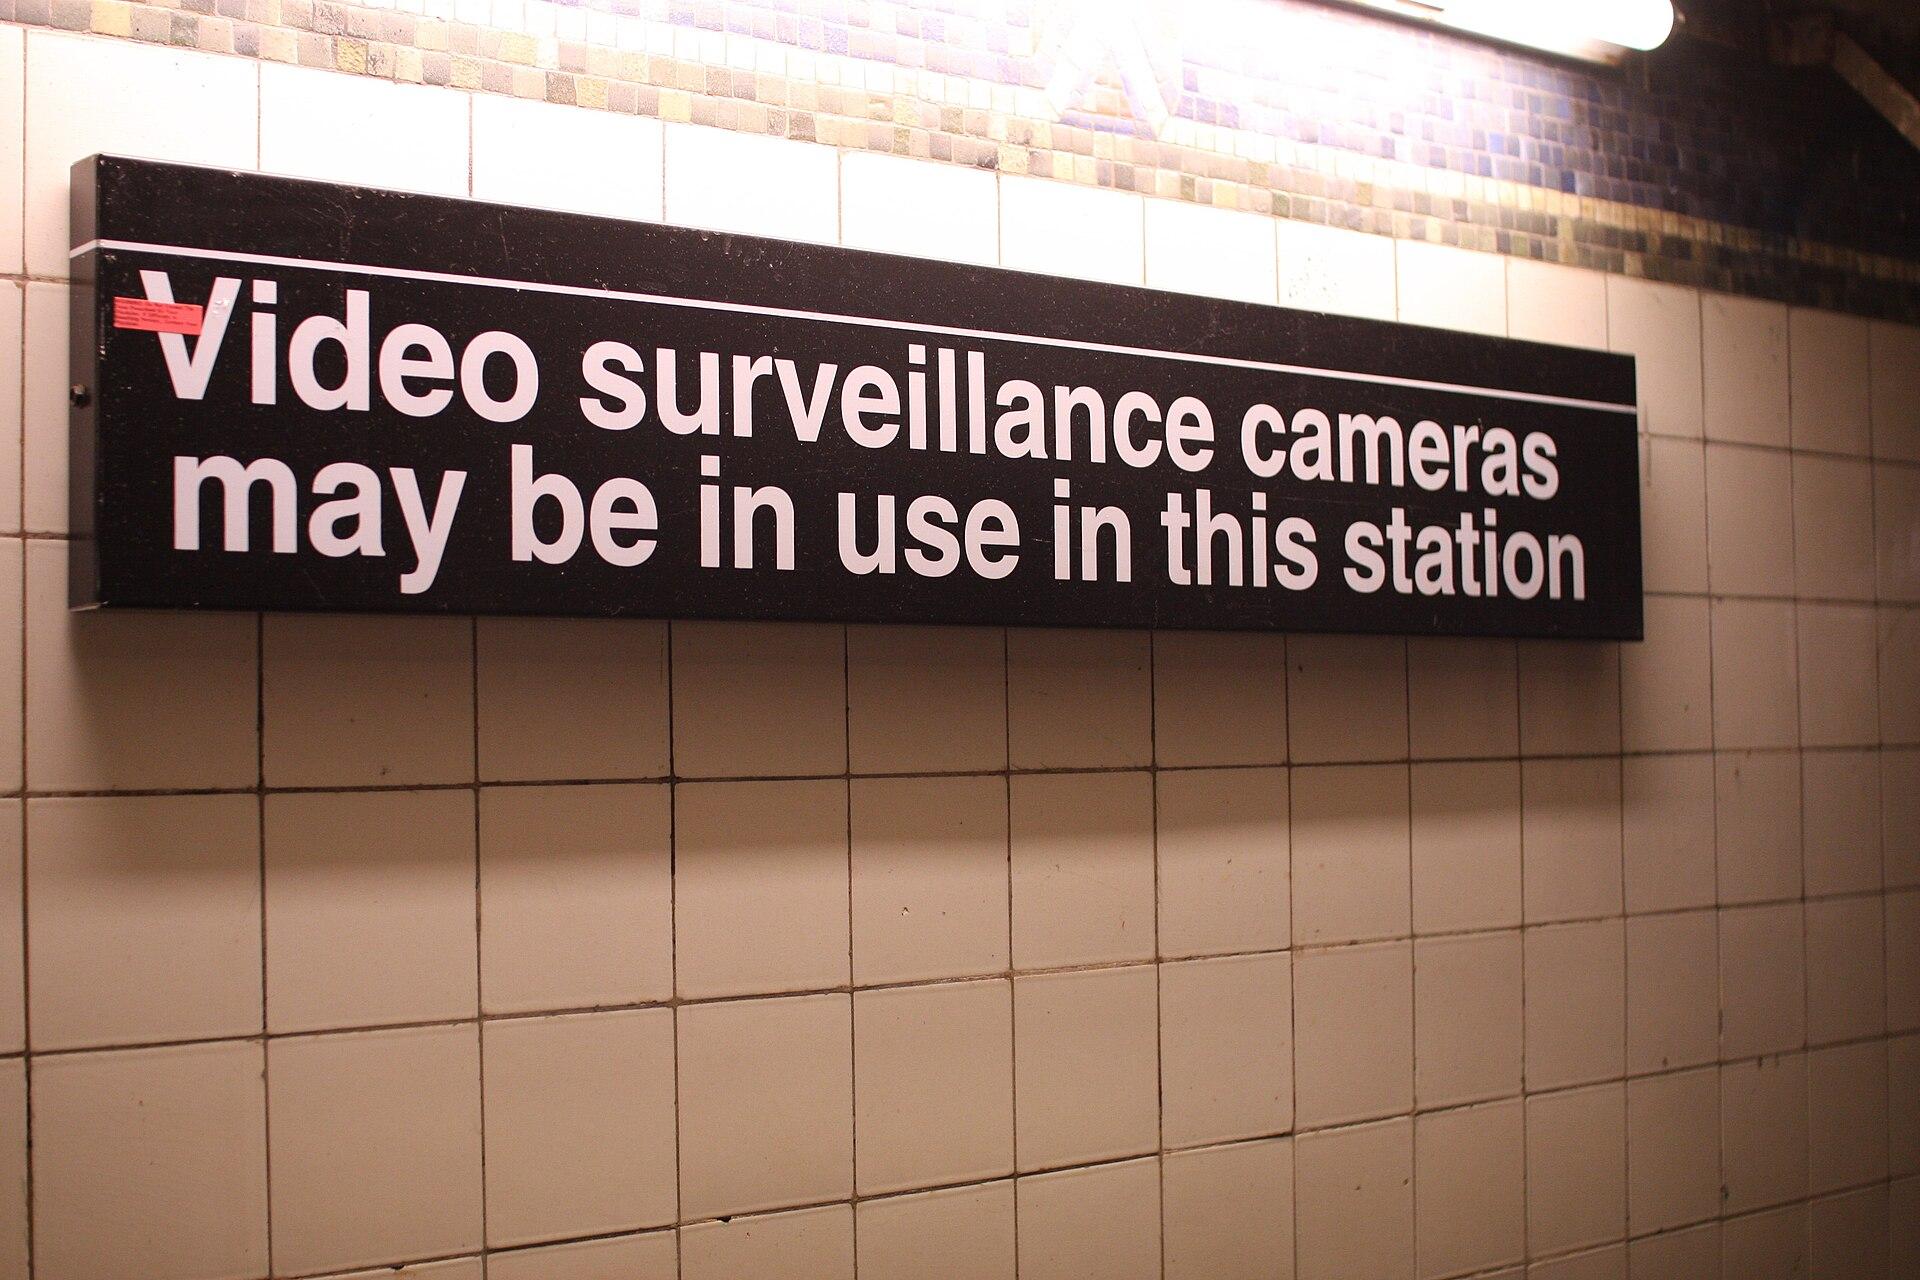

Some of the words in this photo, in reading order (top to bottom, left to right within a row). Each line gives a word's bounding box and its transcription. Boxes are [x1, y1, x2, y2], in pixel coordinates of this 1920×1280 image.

[139, 269, 539, 423] Video
[580, 341, 1214, 472] surveillance
[1241, 404, 1558, 499] cameras
[174, 456, 467, 593] may
[512, 444, 658, 570] be
[701, 455, 795, 571] in
[838, 484, 1020, 580] use
[1054, 478, 1132, 582] in
[1161, 489, 1318, 592] this
[1344, 506, 1585, 600] station
